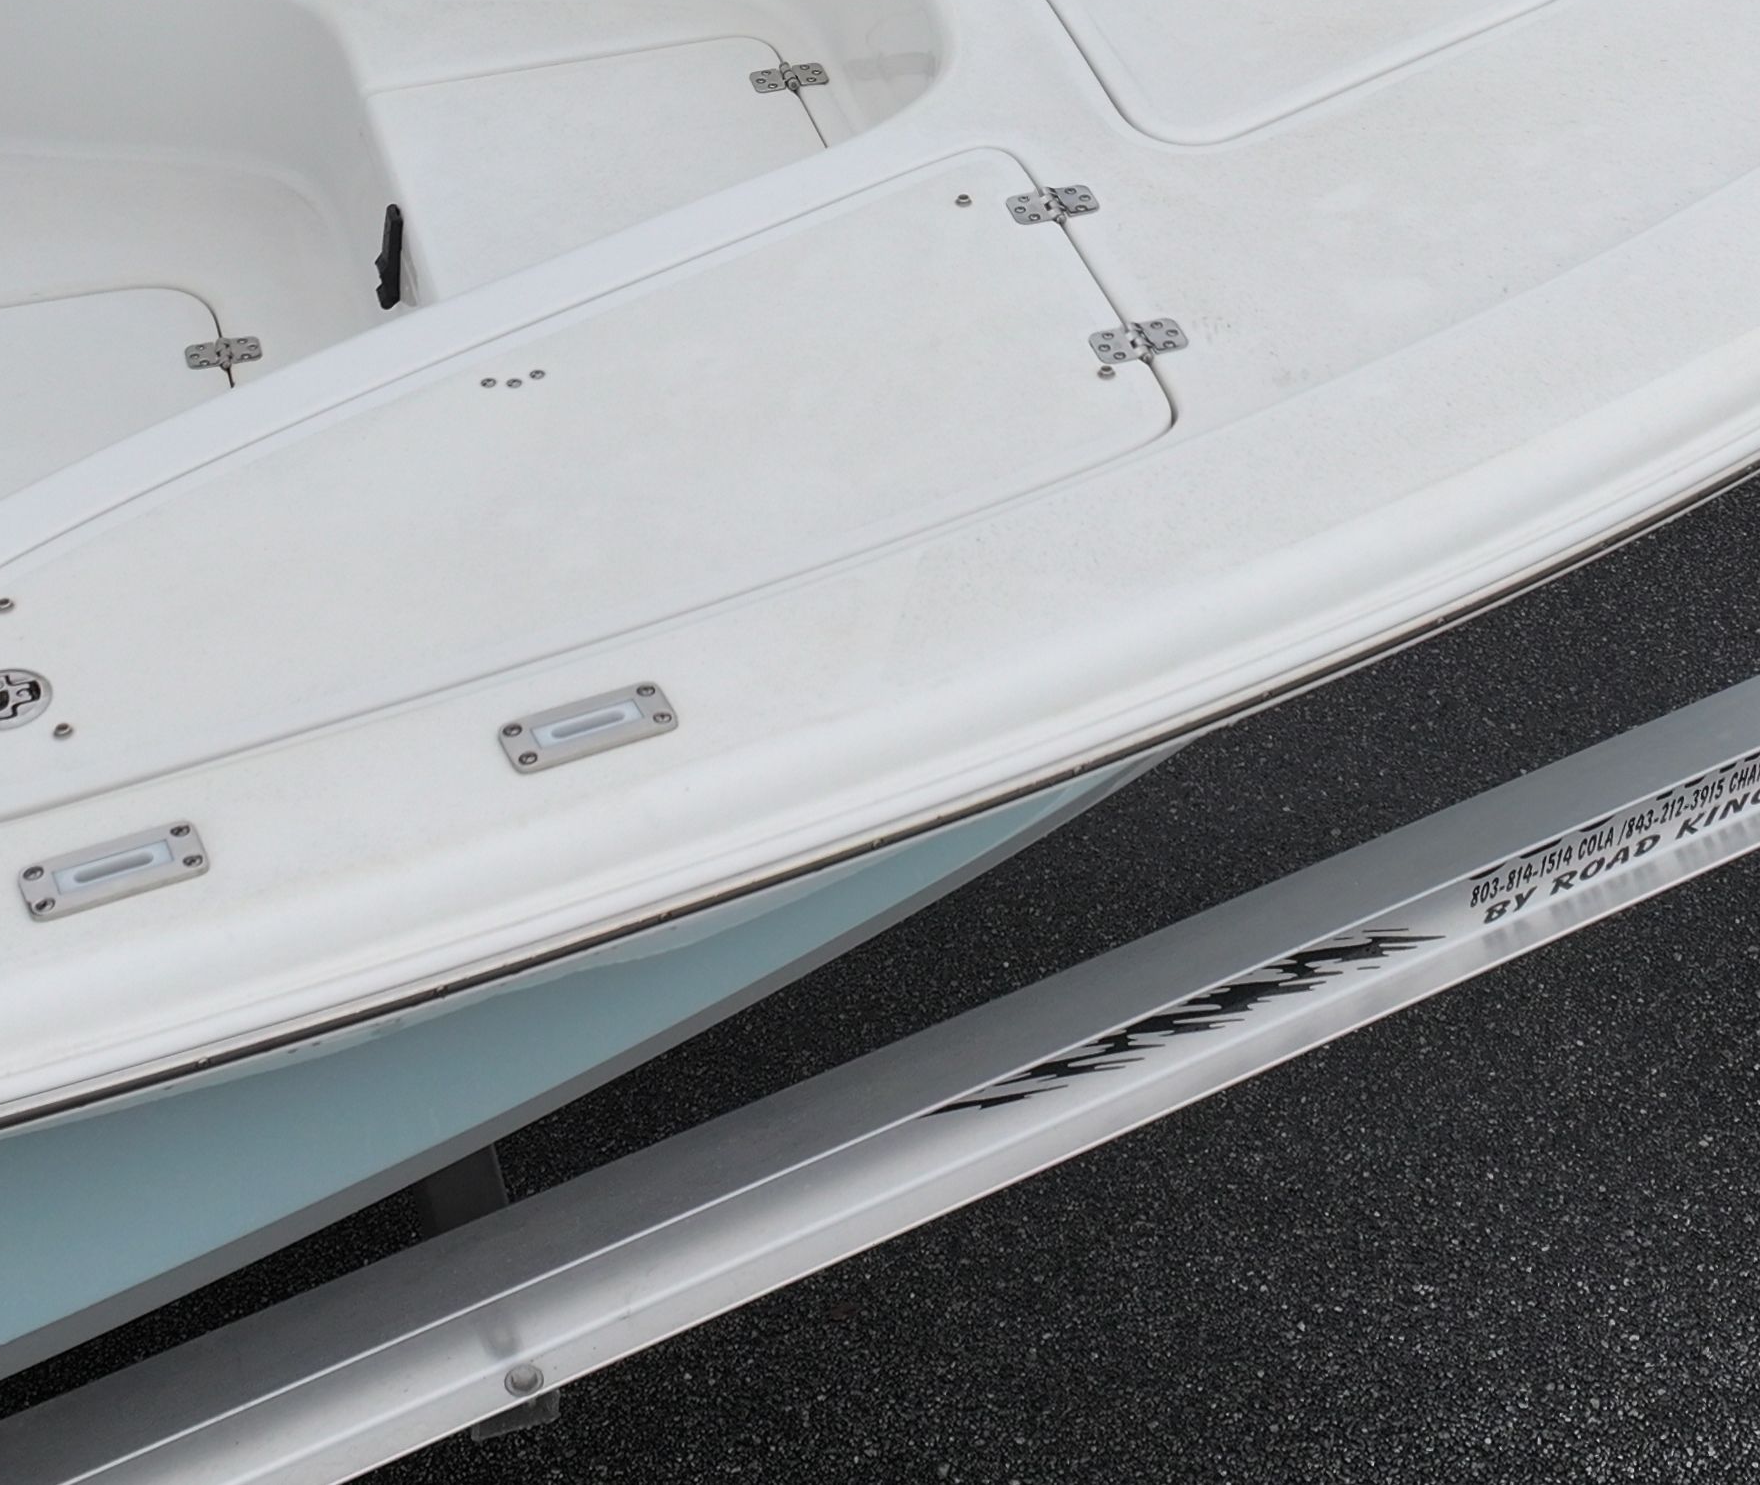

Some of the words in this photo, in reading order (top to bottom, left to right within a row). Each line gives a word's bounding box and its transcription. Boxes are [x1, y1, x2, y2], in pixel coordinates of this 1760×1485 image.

[1470, 845, 1573, 908] 803-814-1514
[1578, 826, 1614, 862] COLA
[1483, 885, 1537, 924] BY
[1549, 833, 1661, 896] ROAD
